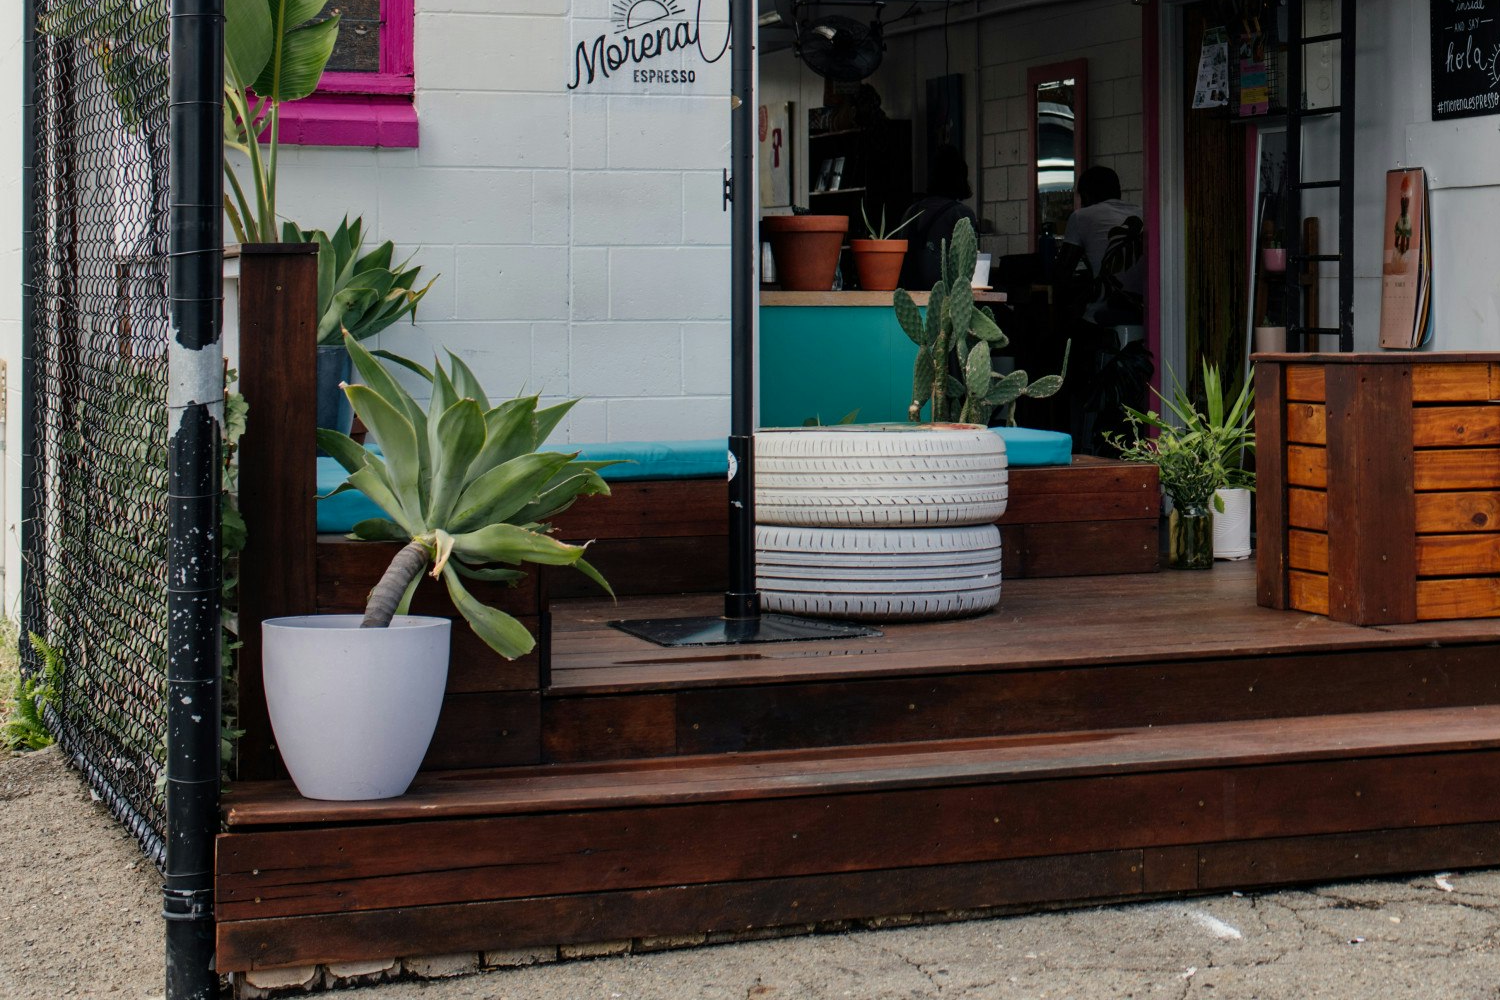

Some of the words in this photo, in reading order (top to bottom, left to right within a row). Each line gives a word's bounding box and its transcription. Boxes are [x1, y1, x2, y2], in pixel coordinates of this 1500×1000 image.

[1467, 17, 1480, 31] SAY
[567, 21, 700, 90] Morena
[1445, 34, 1488, 73] hola
[633, 69, 696, 84] ESPRESSO
